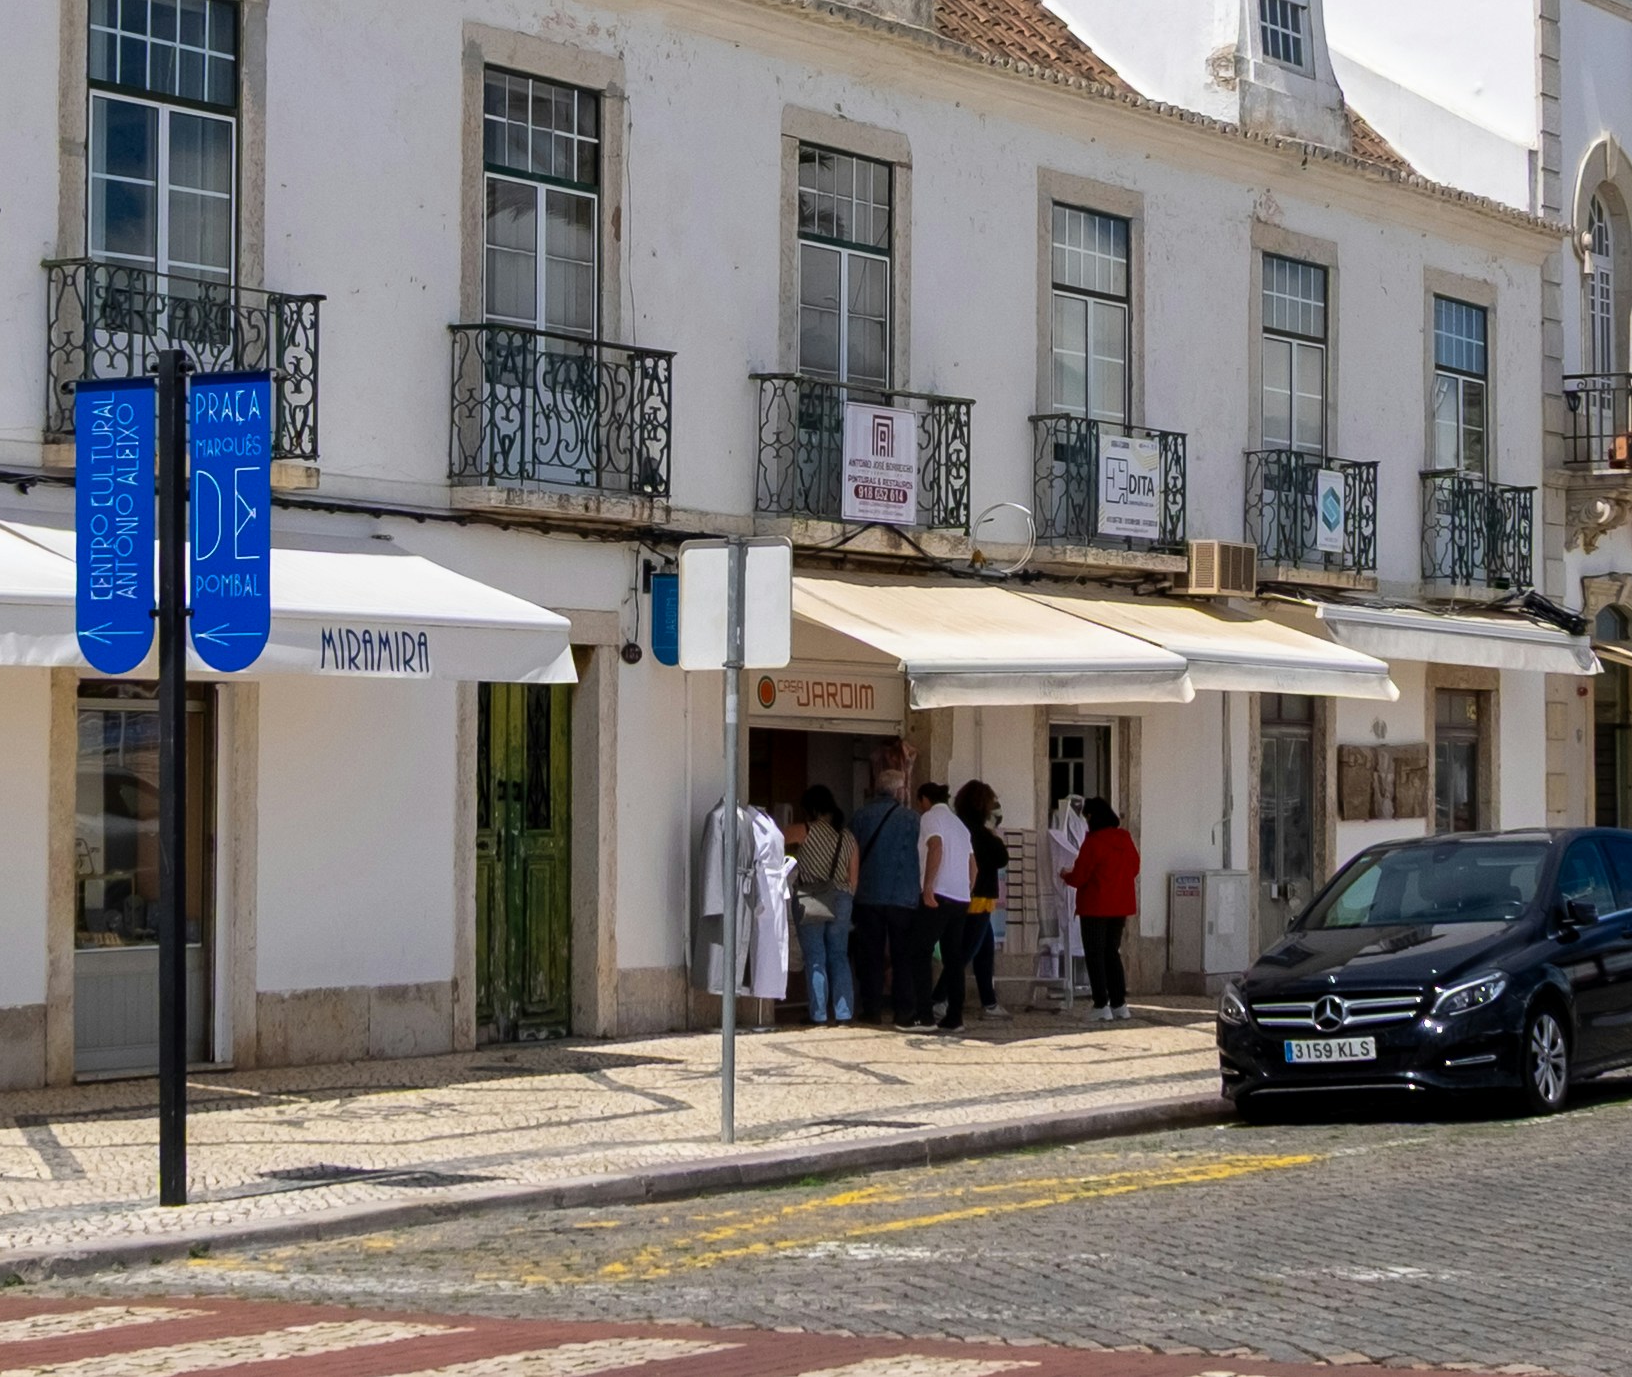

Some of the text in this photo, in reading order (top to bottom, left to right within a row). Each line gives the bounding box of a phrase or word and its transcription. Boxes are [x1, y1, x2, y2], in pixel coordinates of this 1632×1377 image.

[195, 388, 261, 425] PRAÇA
[116, 403, 139, 486] ALEIXO
[195, 433, 262, 459] MARQUÊS
[90, 391, 114, 600] CENTRO CULTURAL
[1129, 474, 1154, 497] DITA
[195, 466, 261, 561] DE
[195, 573, 262, 599] POMBAL
[321, 627, 430, 673] MIRAMIRA
[777, 679, 874, 710] CASA JARDIM
[1295, 1041, 1370, 1059] 3159 KLS
